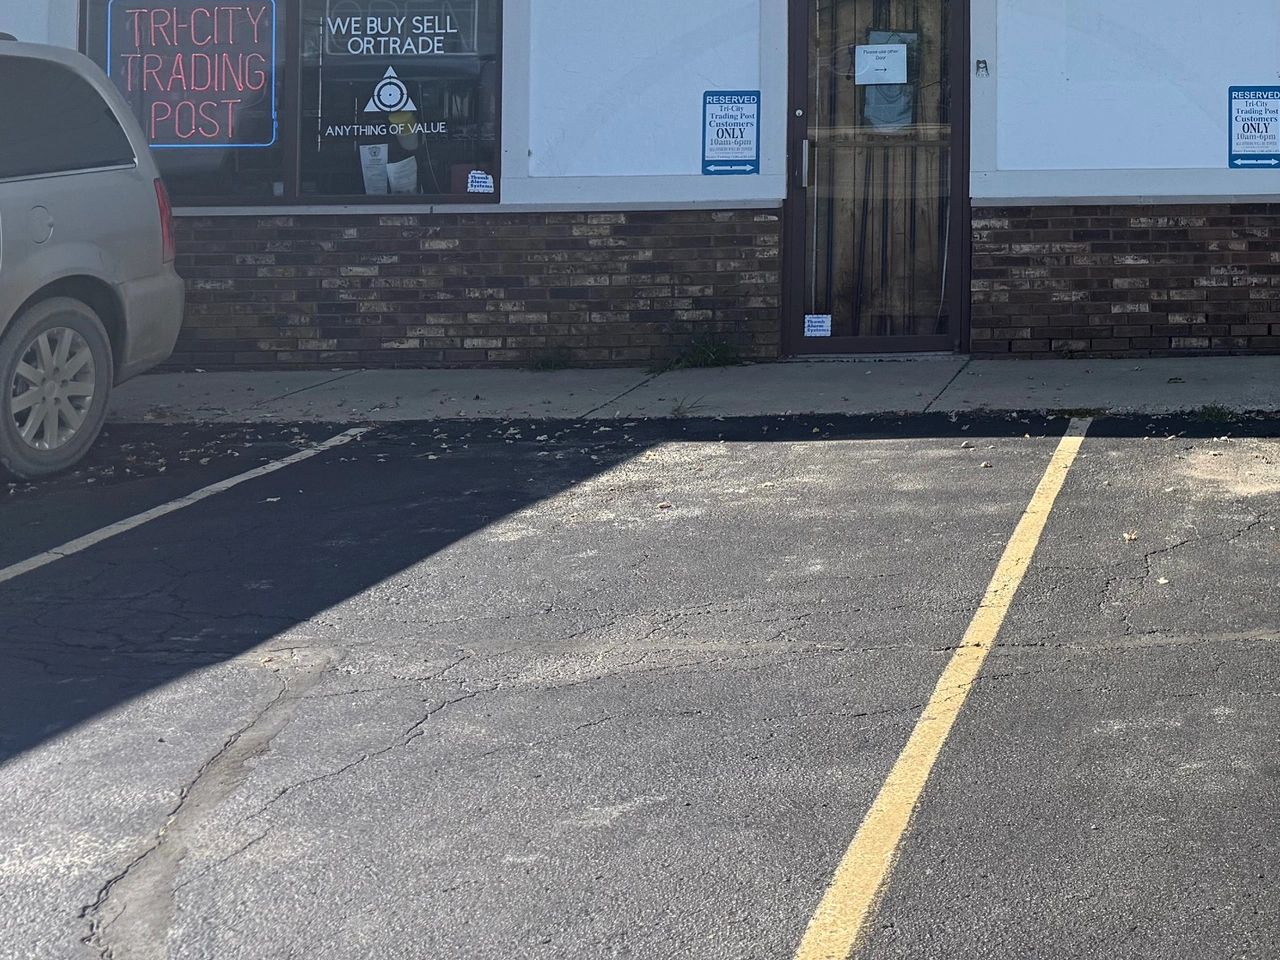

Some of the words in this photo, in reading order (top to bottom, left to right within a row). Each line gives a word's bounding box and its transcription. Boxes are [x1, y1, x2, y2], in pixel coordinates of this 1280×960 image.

[126, 6, 266, 48] TRI-CITY
[327, 16, 362, 34] WE
[366, 16, 406, 34] BUY
[412, 15, 457, 33] SELL
[121, 52, 266, 91] TRADING
[1232, 91, 1280, 99] RESERVED
[151, 99, 241, 138] POST
[325, 124, 387, 137] ANYTHING
[389, 123, 405, 135] OF
[407, 122, 447, 133] VALUE
[716, 128, 746, 139] ONLY
[1242, 123, 1270, 133] ONLY
